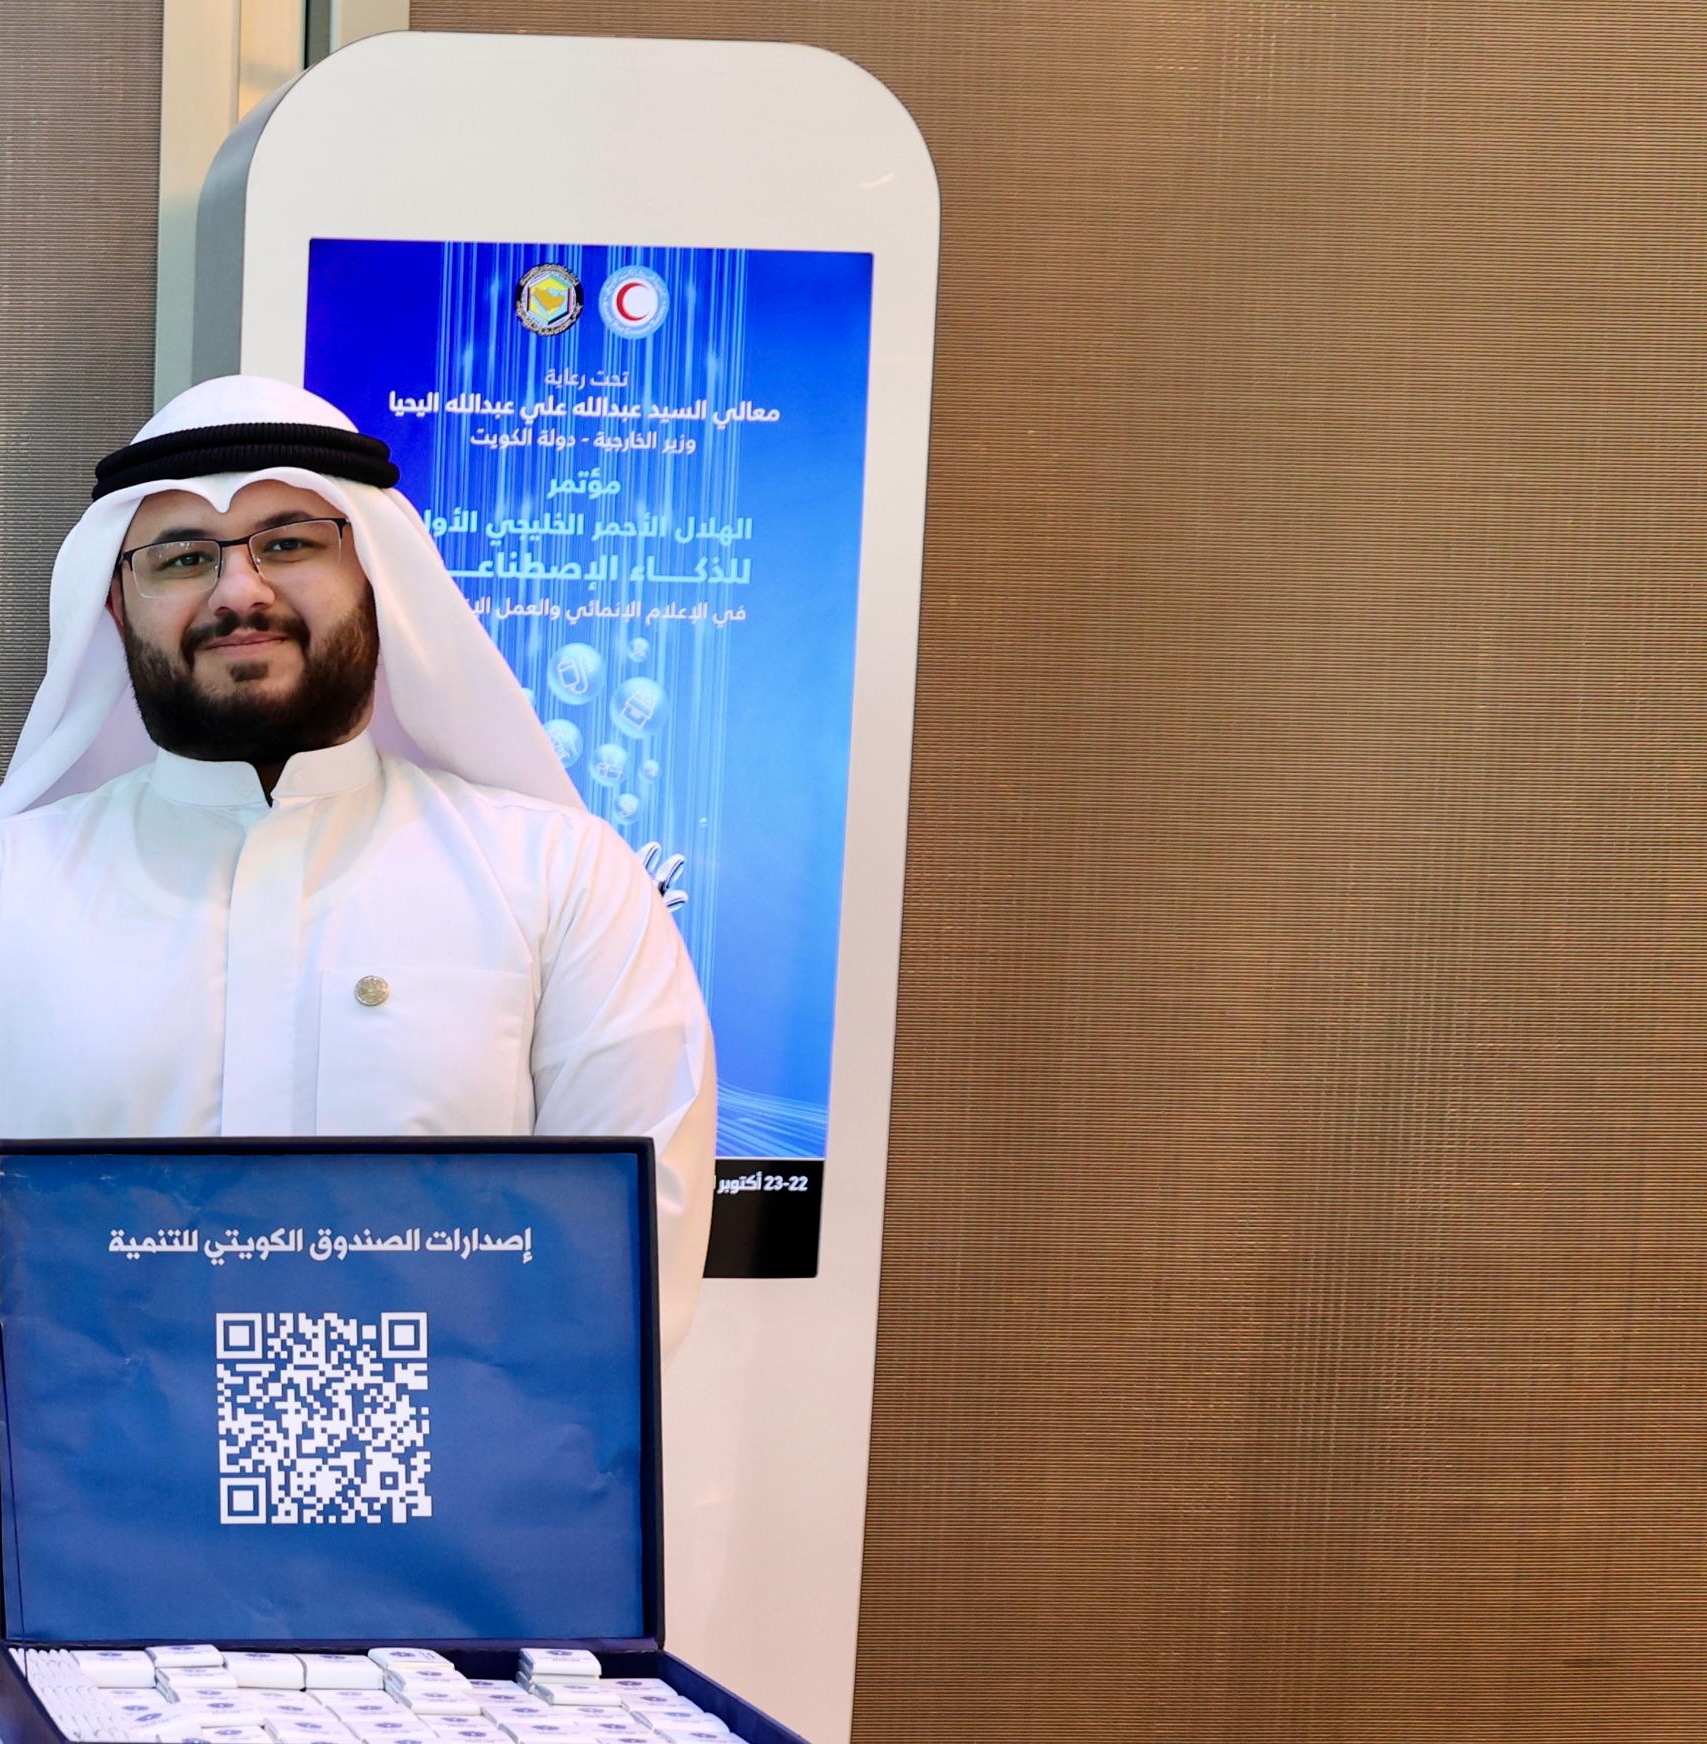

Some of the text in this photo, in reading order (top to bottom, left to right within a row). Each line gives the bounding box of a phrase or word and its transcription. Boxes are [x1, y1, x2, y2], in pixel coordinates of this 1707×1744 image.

[545, 369, 629, 389] تحت رعاية
[388, 390, 780, 429] معالي السيد عبدالله علي عبدالله اليحيا
[471, 429, 532, 450] الكويت
[537, 430, 576, 449] دولة
[594, 431, 656, 453] الخارجية
[662, 438, 696, 455] وزير
[547, 467, 621, 499] مؤتمر
[487, 513, 584, 546] الخليجي
[592, 512, 666, 541] الأحمر
[675, 516, 752, 545] الهلال
[448, 551, 751, 591] للذكاء الإصطناع
[496, 598, 560, 619] والعمل
[565, 600, 641, 625] الإنمائي
[645, 601, 707, 625] الإعلام
[712, 606, 746, 629] في
[716, 1171, 763, 1195] أكتوبر
[108, 1227, 533, 1267] إصدارات الصندوق الكويتي للتنمية
